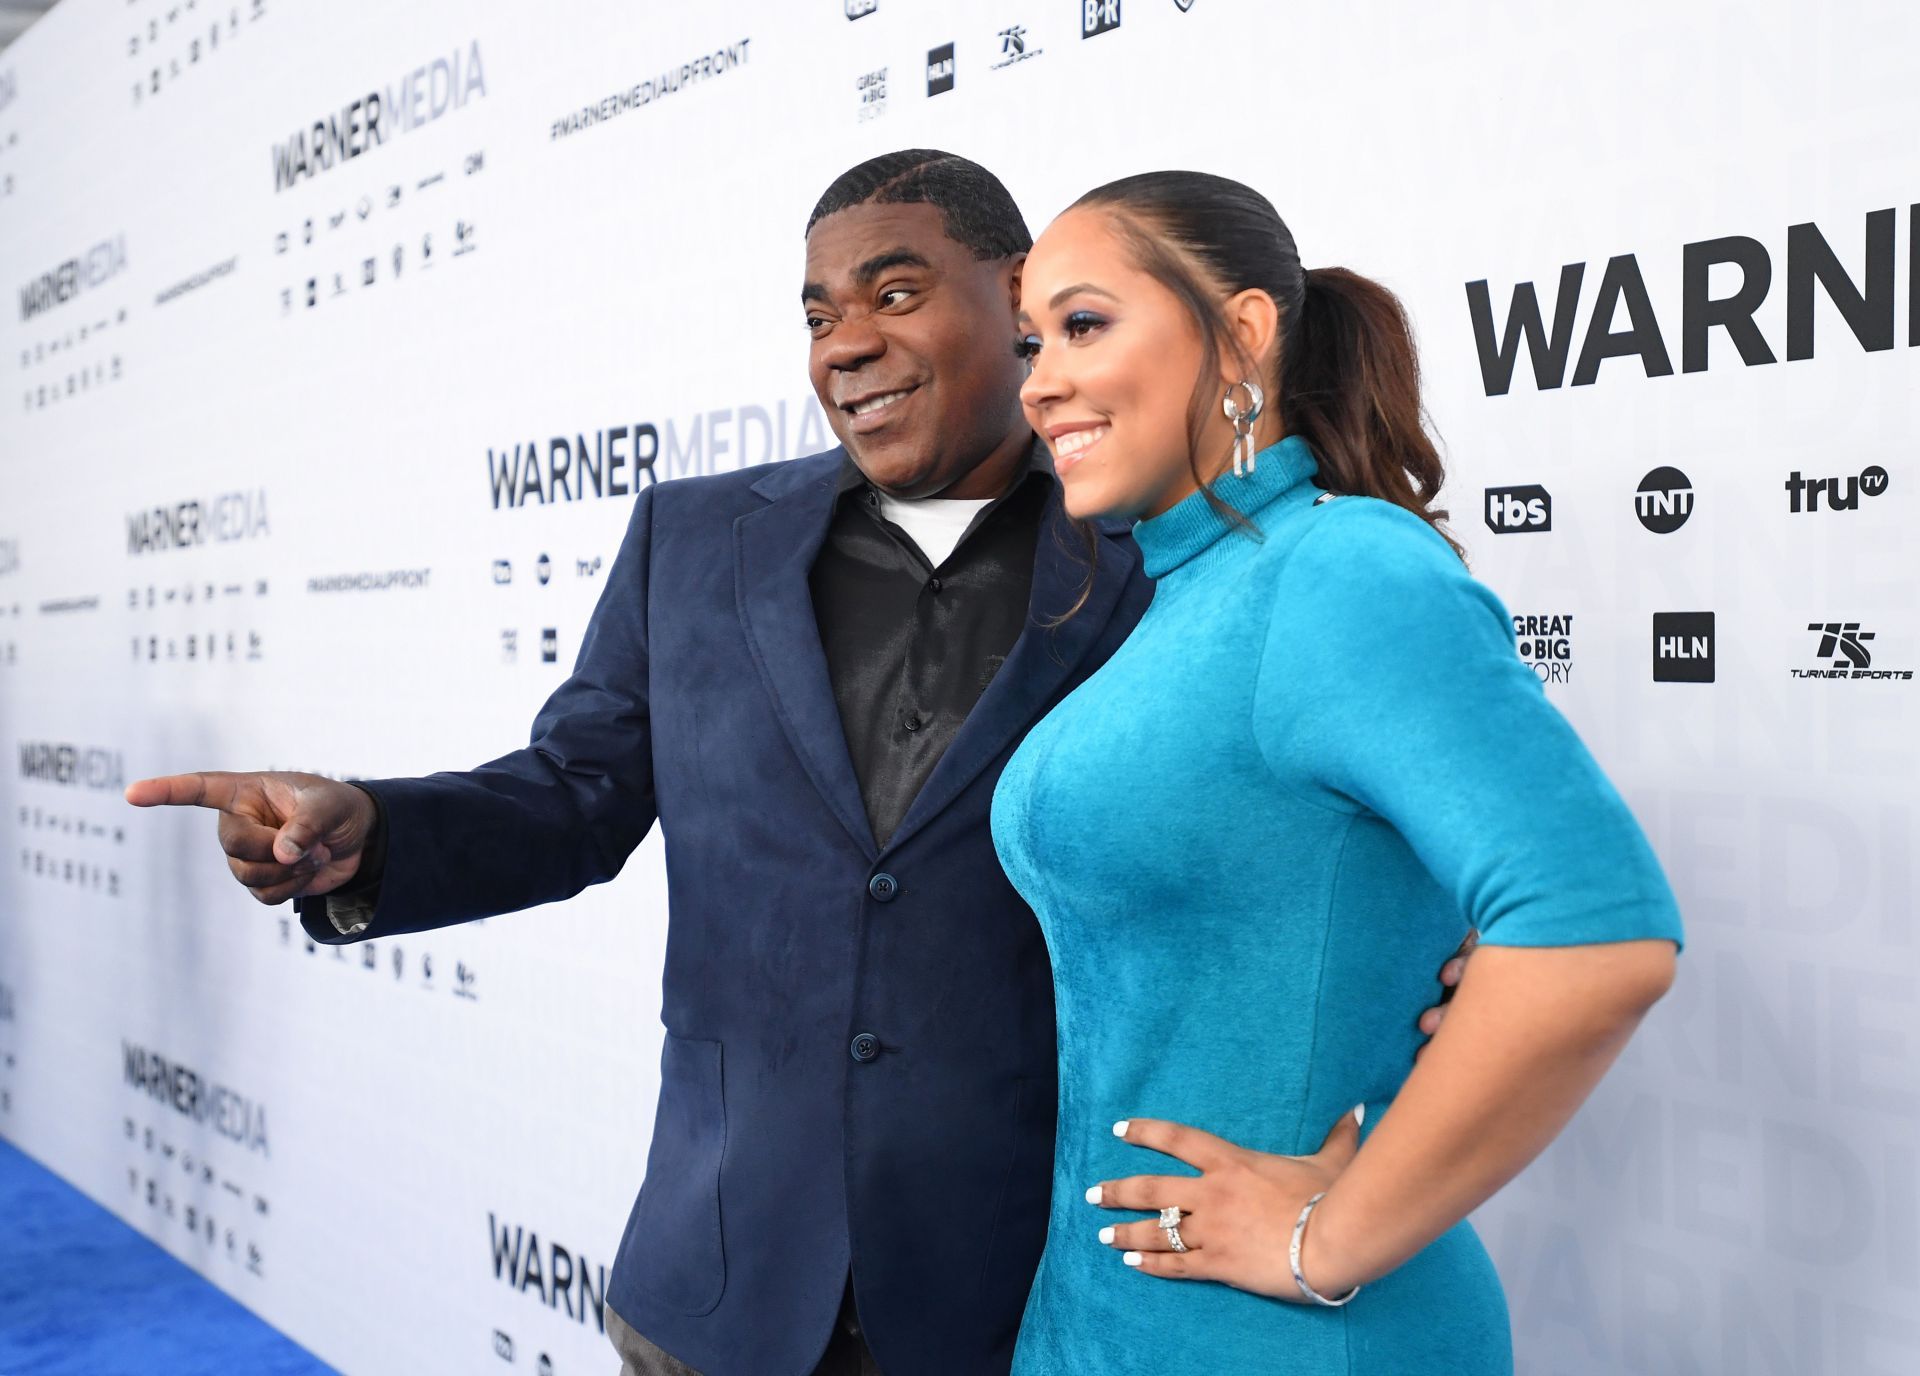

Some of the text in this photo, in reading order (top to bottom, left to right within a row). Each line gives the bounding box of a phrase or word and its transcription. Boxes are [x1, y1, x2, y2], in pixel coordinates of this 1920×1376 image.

[550, 38, 750, 141] #WARNERMEDIAUPFRONT
[856, 67, 888, 90] GREAT
[272, 38, 486, 194] WARNERMEDIA
[1465, 203, 1920, 396] WARN
[488, 394, 828, 510] WARNERMEDIA
[1490, 493, 1547, 527] tbs
[1635, 487, 1694, 517] TNT
[1512, 615, 1573, 636] GREAT
[1534, 638, 1571, 660] BIG
[1660, 636, 1708, 659] HLN
[1523, 662, 1573, 684] TORY
[1790, 669, 1914, 680] TURNER SPORTS
[488, 1211, 610, 1335] WARN
